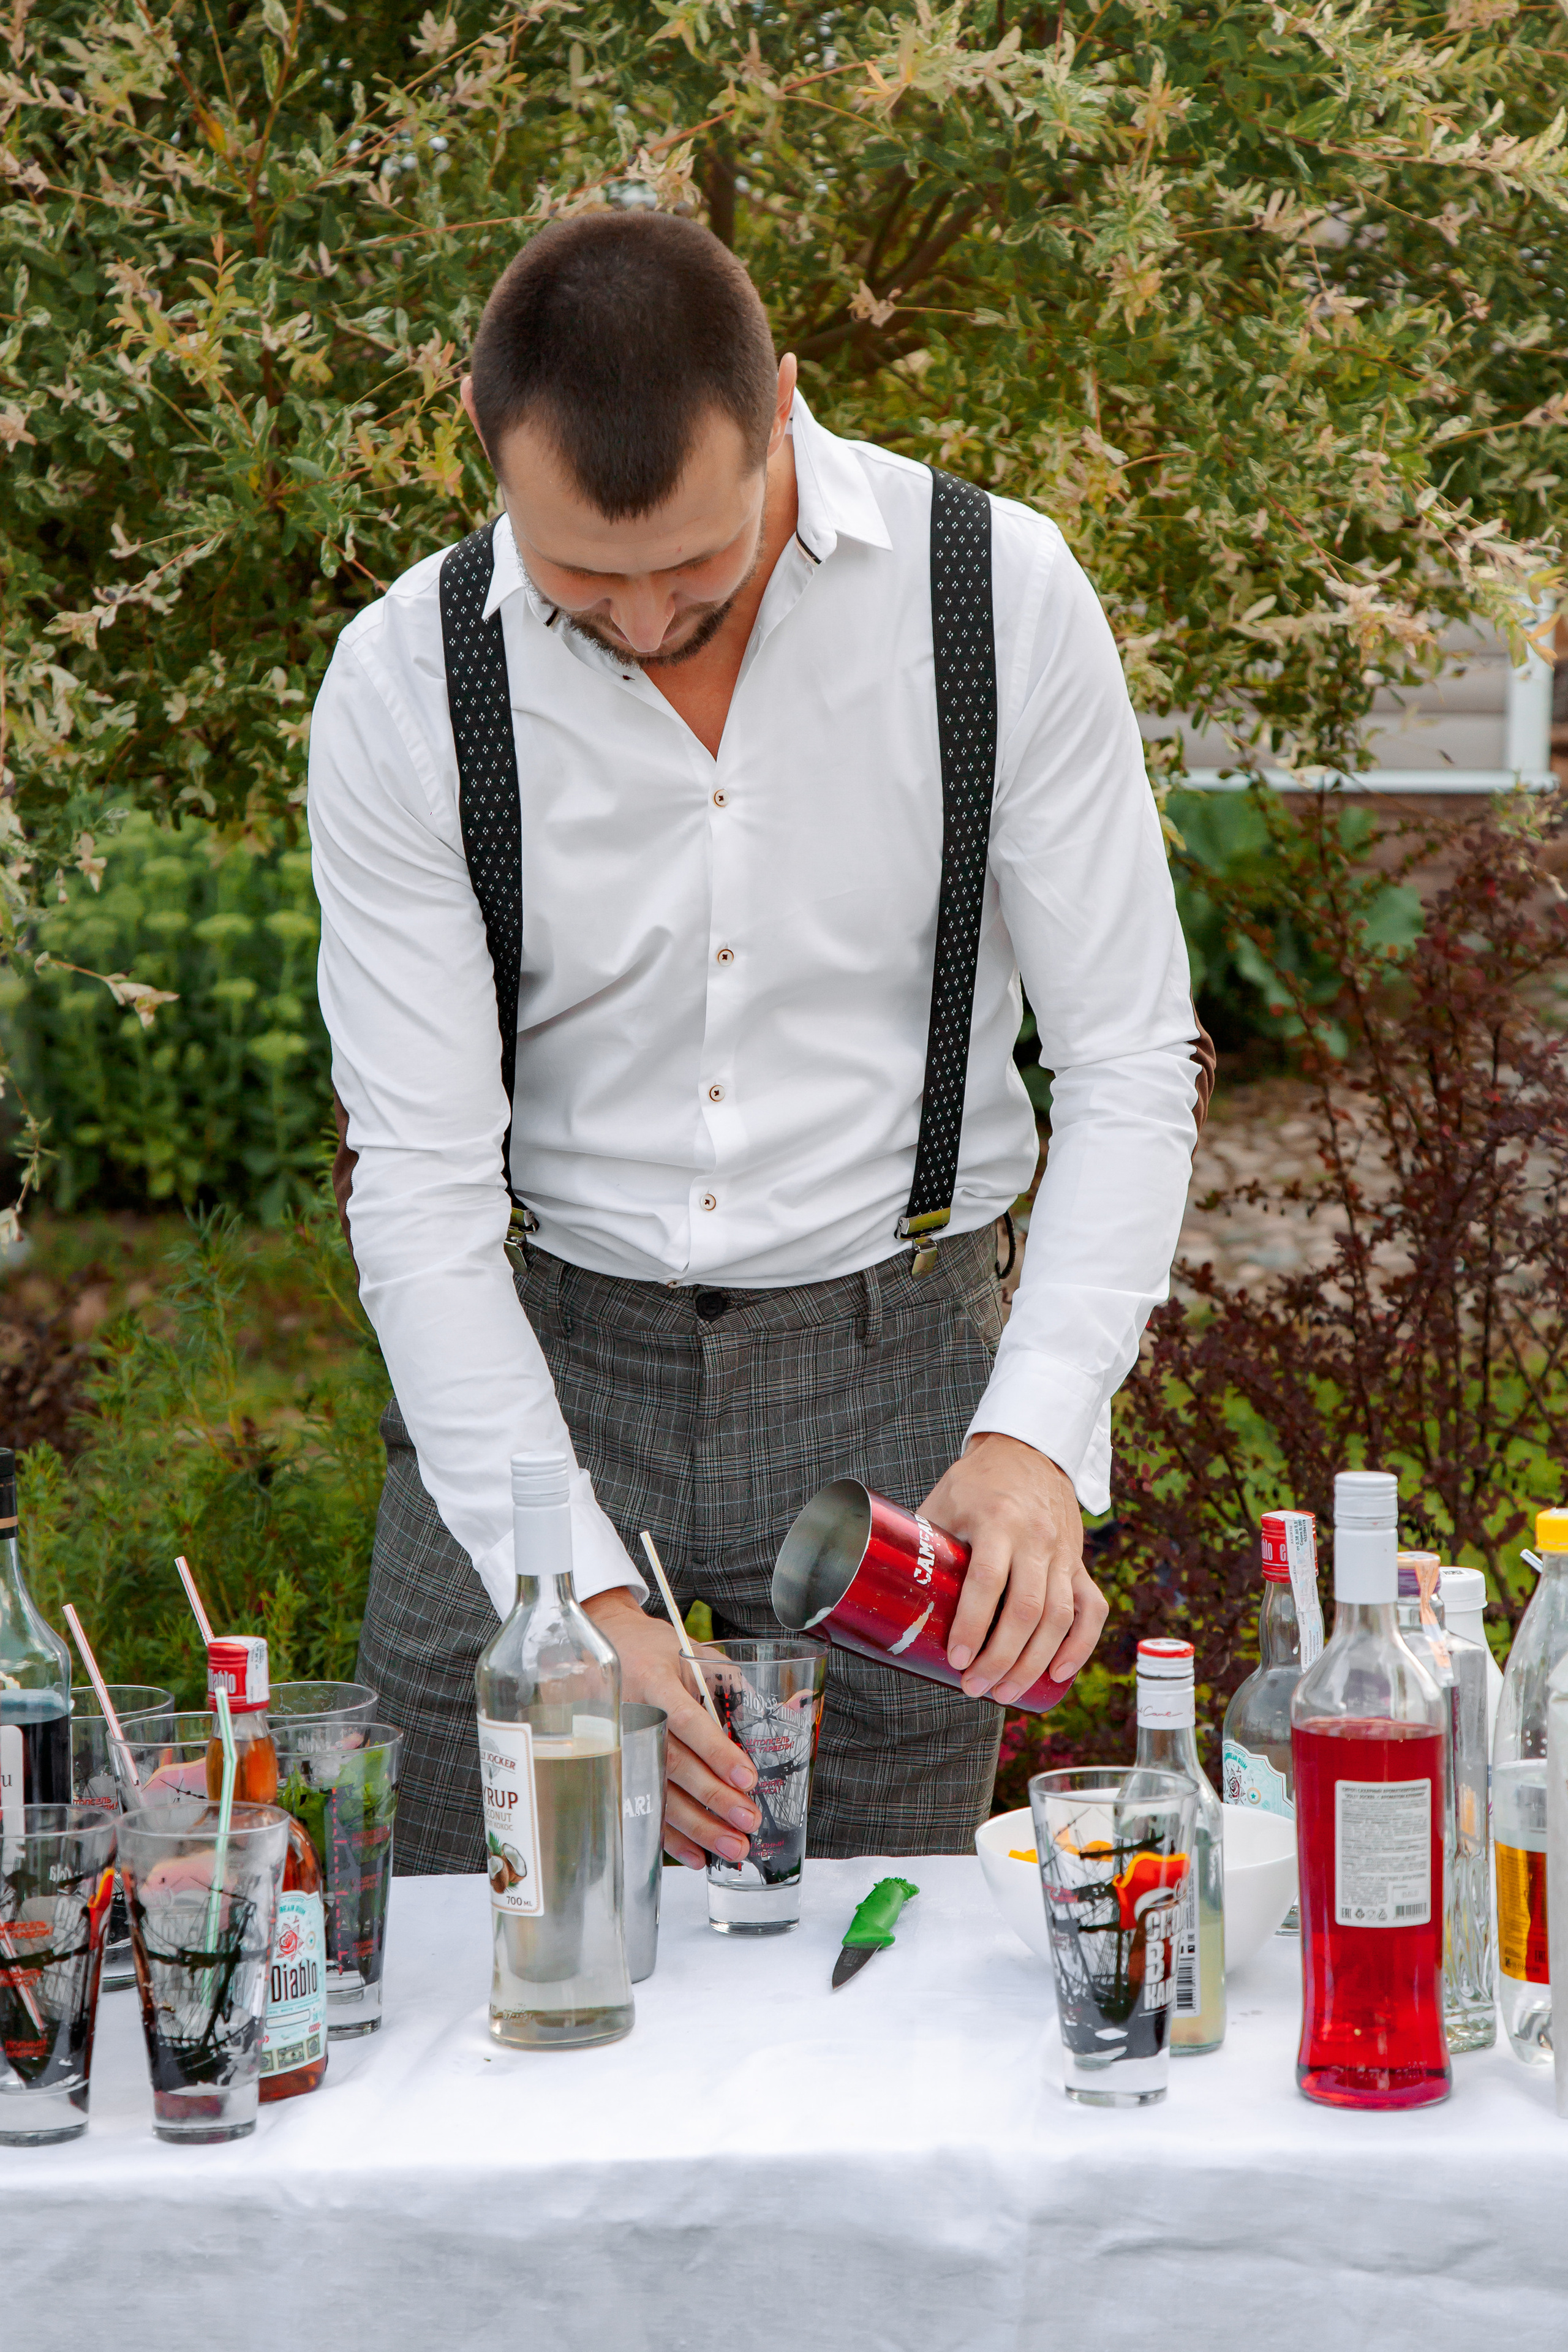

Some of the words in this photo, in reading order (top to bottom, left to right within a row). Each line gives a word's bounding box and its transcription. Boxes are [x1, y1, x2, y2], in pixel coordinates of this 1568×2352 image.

[487, 1753, 516, 1770] JOCKER
[482, 1785, 518, 1809] YRUP
[506, 1896, 522, 1906] 700
[271, 1958, 317, 2003] Diablo
